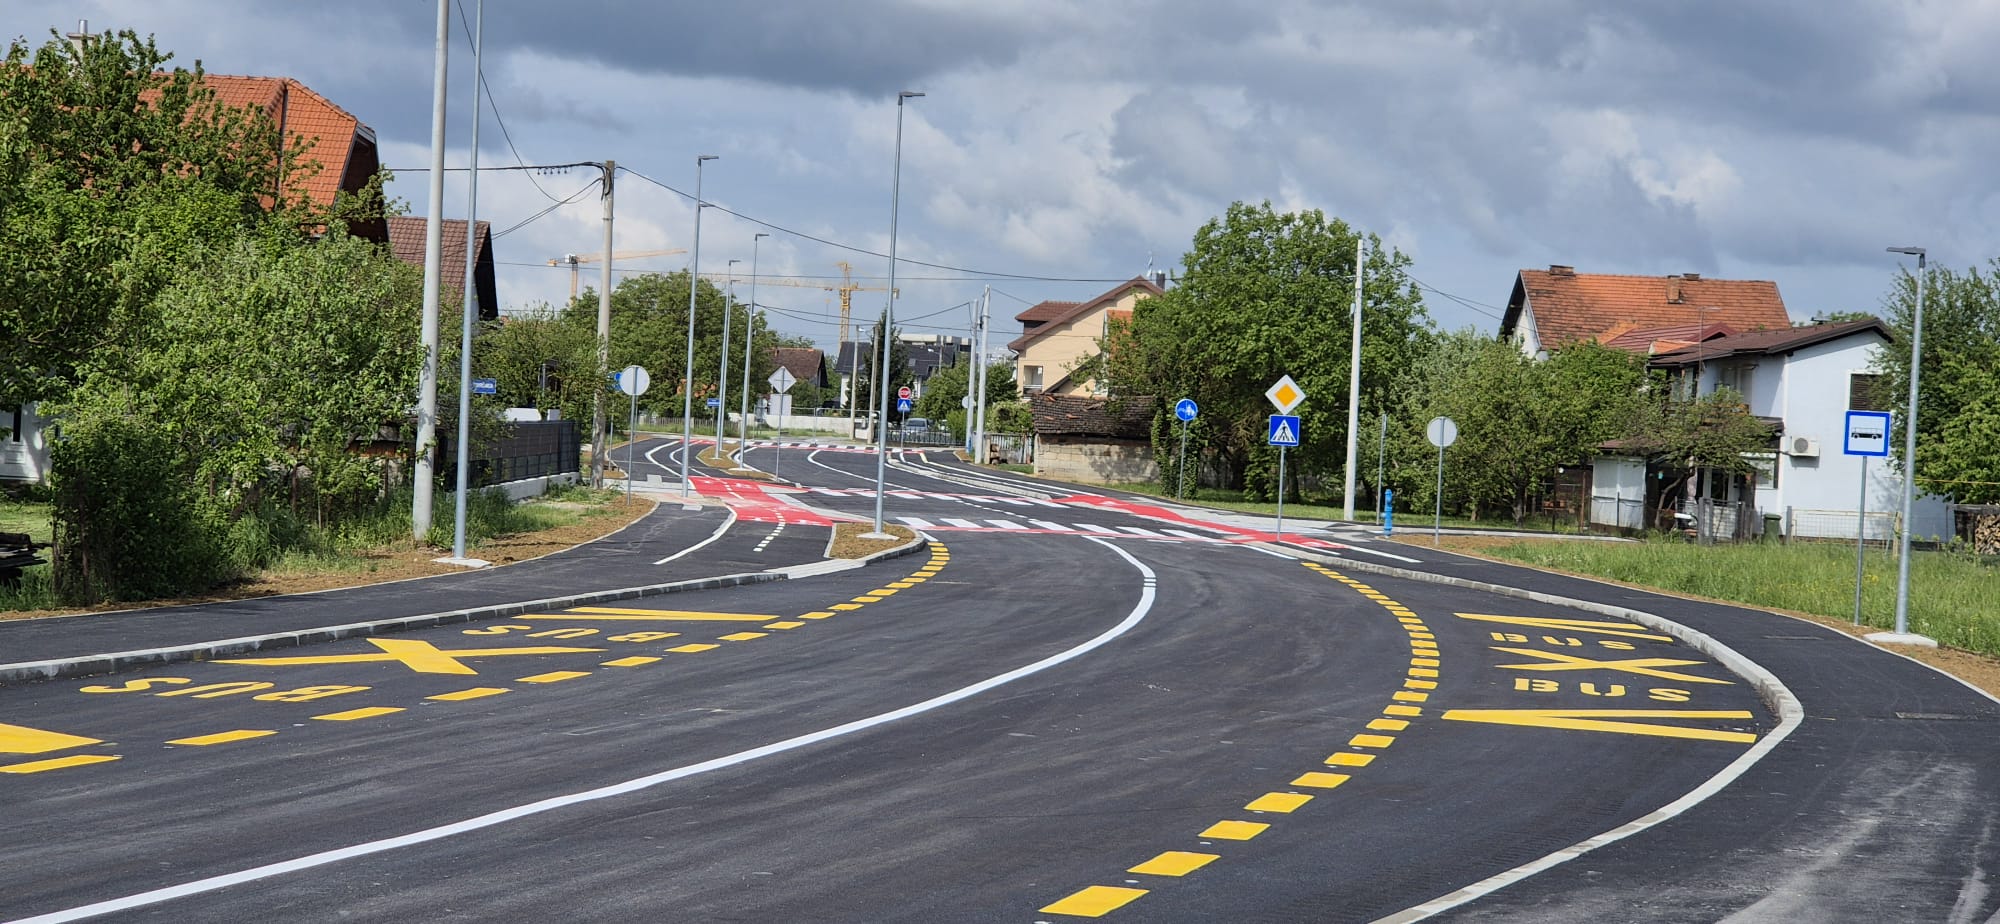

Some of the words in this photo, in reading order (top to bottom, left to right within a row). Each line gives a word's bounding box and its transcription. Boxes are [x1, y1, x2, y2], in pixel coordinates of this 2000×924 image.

[461, 625, 682, 643] BUS
[1490, 632, 1636, 650] BUS
[79, 677, 372, 702] BUS
[1513, 678, 1692, 702] BUS
